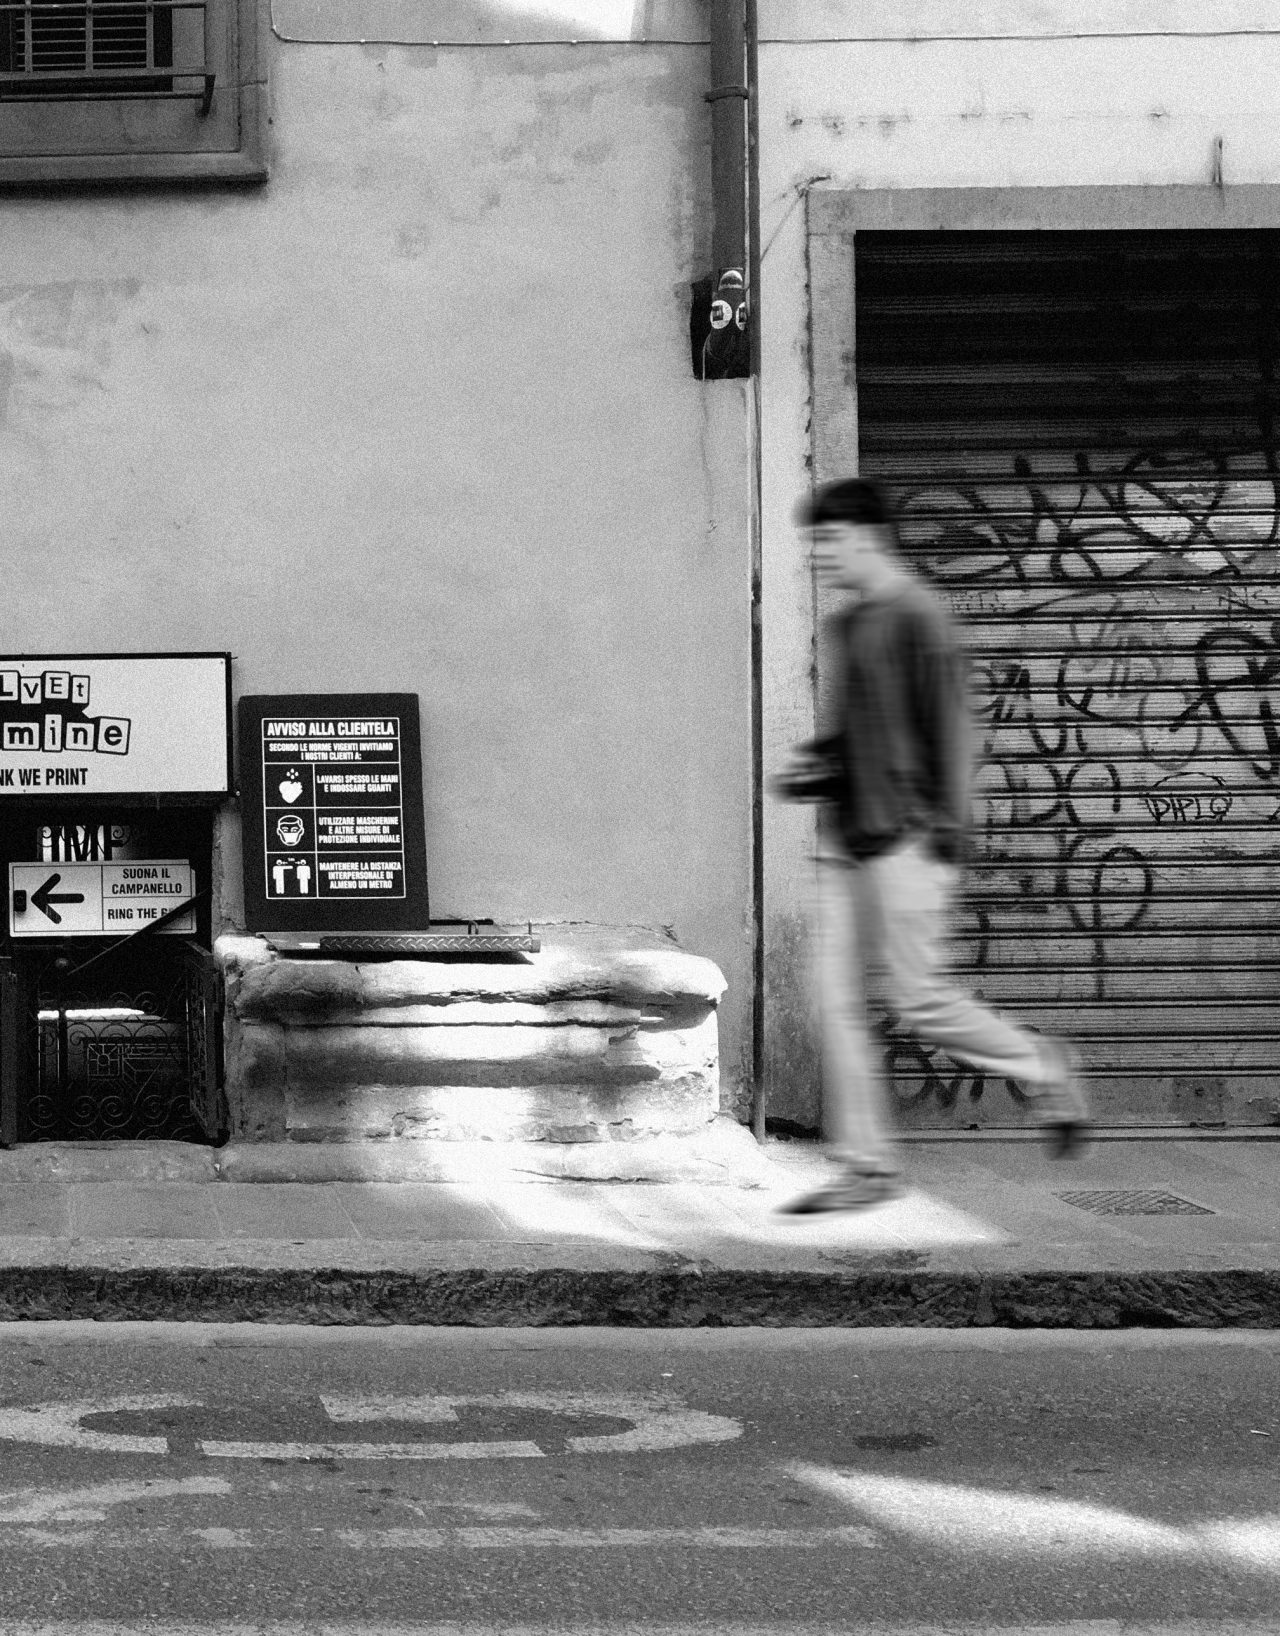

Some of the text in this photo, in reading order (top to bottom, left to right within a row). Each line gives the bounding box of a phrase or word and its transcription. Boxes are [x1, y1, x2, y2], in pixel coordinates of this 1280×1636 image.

[267, 721, 395, 736] AVVISO ALLA CLIENTELA
[269, 742, 394, 752] SECONDO LE NORME VIGENTI INVITIAMO
[305, 752, 328, 761] NOSTRI
[329, 752, 354, 760] CLIENTI
[354, 752, 362, 760] A:
[18, 768, 42, 787] WE
[45, 767, 89, 786] PRINT
[316, 774, 399, 783] LAVARSI SPESSO LE MANI
[324, 784, 392, 793] E INDOSSARE GUANTI
[318, 816, 399, 825] UTILIZZARE MASCHERINE
[328, 826, 390, 834] E ALTRE MISURE DI
[318, 835, 401, 844] PROTEZIONE INDIVIDUALE
[319, 862, 402, 871] MANTENERE LA DISTANZA
[122, 867, 171, 879] SUONA IL
[328, 871, 394, 880] INTERPERSONALE DI
[111, 883, 182, 894] CAMPANELLO
[329, 880, 393, 889] ALMENO UN METRO
[107, 908, 134, 920] RING
[136, 908, 158, 919] THE
